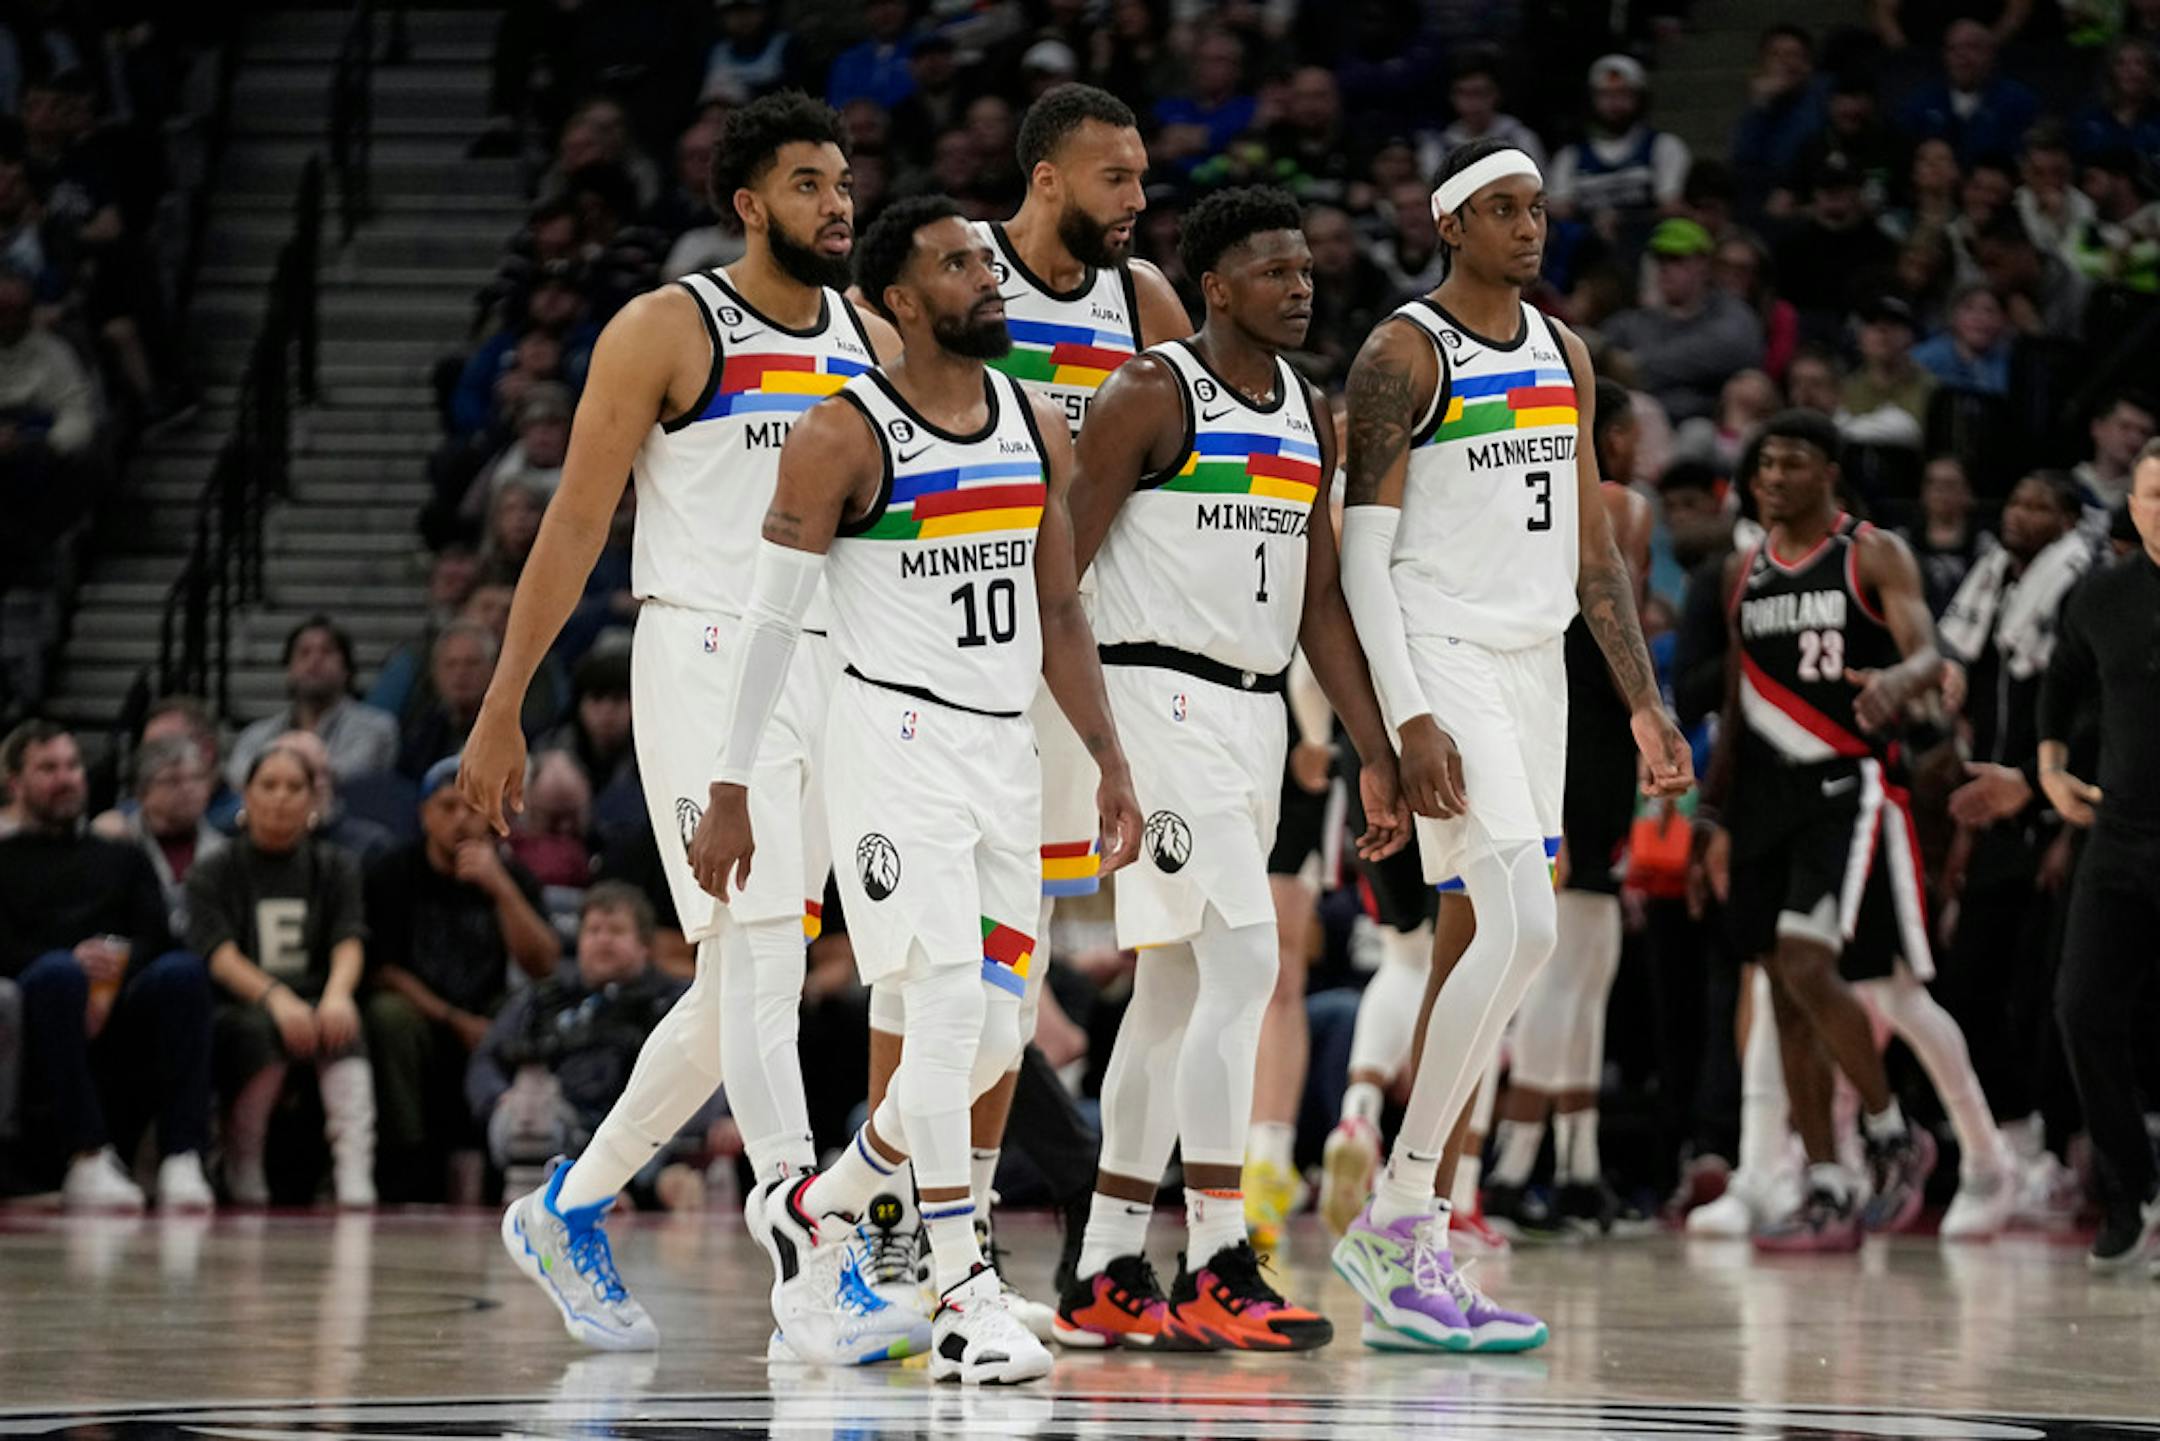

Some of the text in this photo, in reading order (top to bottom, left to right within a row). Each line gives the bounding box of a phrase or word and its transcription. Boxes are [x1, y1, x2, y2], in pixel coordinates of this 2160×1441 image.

[719, 307, 738, 325] 6
[1197, 381, 1214, 401] 6
[890, 421, 911, 442] 6
[1467, 435, 1577, 472] MINNESOT
[1525, 471, 1552, 532] 3
[901, 539, 1033, 579] MINNESO
[1255, 541, 1268, 603] 1
[951, 578, 1017, 648] 10
[1798, 629, 1845, 682] 23
[257, 899, 308, 974] E
